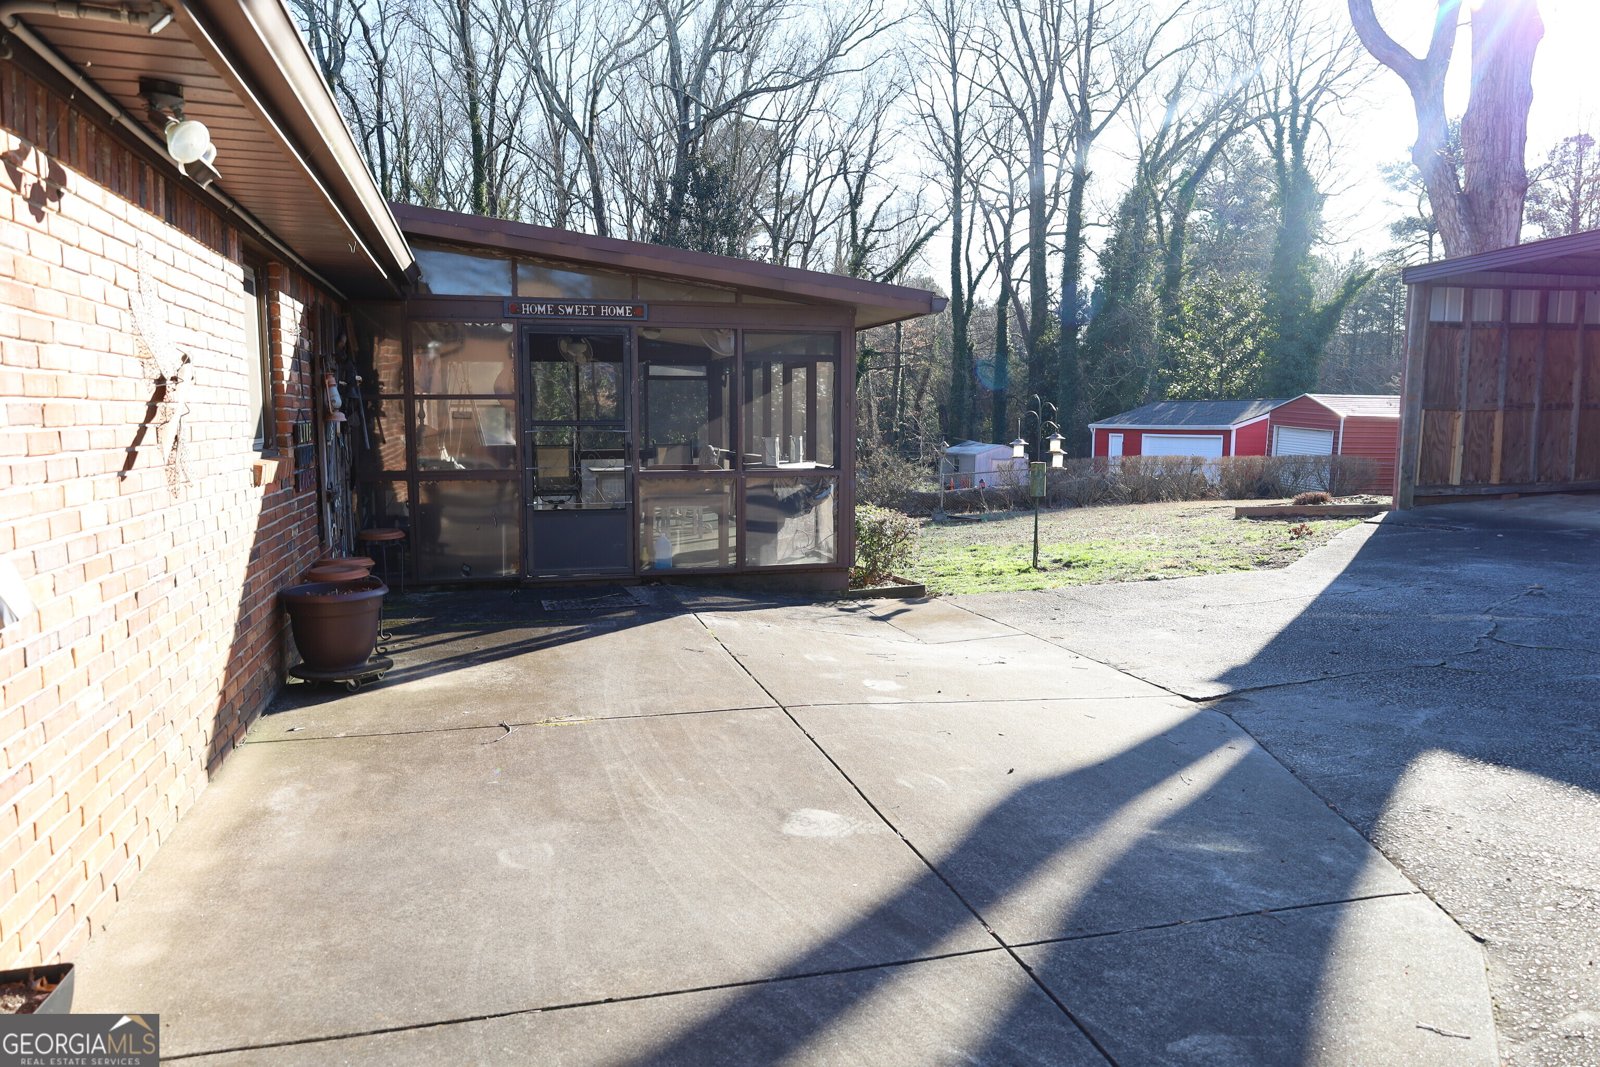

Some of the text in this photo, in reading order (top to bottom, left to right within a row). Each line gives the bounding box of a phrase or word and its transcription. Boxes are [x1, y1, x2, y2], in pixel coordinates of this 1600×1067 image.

[521, 303, 633, 317] HOME SWEET HOME
